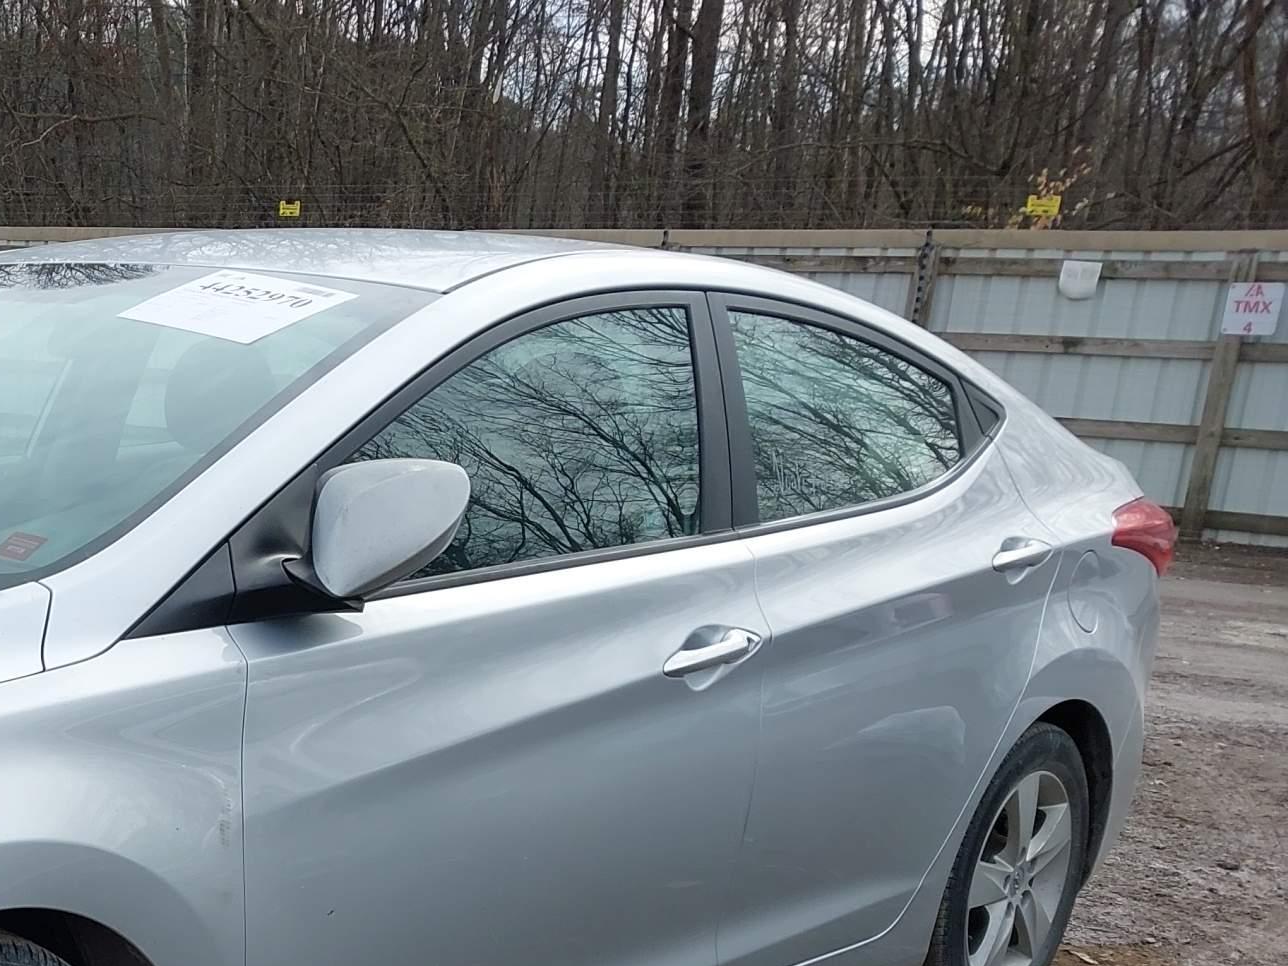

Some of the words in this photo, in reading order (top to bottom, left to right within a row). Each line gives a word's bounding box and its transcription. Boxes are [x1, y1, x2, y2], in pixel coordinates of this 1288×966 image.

[199, 281, 313, 309] 44252970
[1233, 300, 1273, 314] TMX
[1242, 321, 1253, 334] 4
